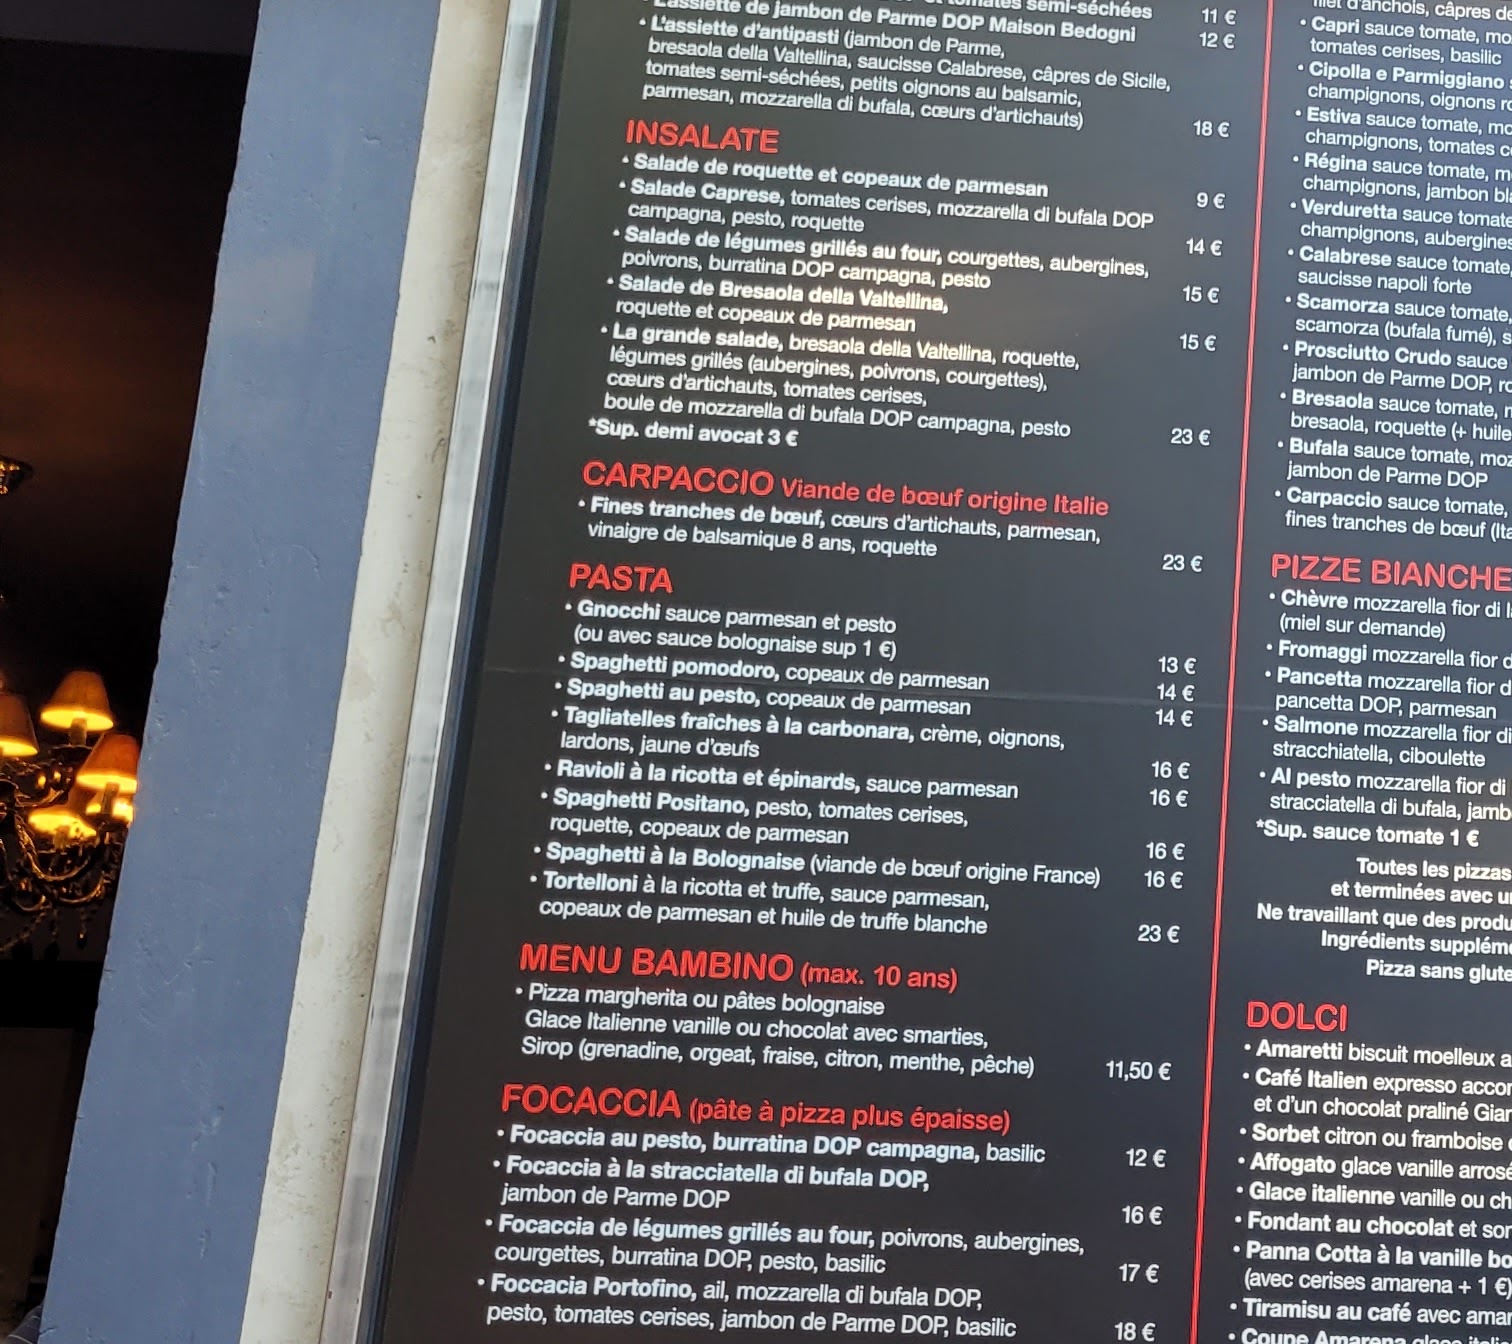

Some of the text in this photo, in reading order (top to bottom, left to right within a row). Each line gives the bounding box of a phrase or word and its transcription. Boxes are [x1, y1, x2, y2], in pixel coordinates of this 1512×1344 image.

[626, 120, 780, 153] INSALATE
[1307, 106, 1361, 124] Estiva
[1366, 114, 1416, 128] sauce
[1421, 115, 1482, 135] tomate,
[634, 153, 1225, 209] Salade de roquette et copeaux de parmesan 9 €
[1298, 270, 1372, 287] saucisse
[1377, 275, 1427, 293] napoli
[1433, 276, 1472, 294] forte
[582, 460, 1109, 516] CARPACCIO Viande de bœuf origine Italie
[569, 563, 673, 593] PASTA
[1272, 554, 1361, 583] PIZZE
[1371, 560, 1512, 591] BIANCHE
[570, 651, 1195, 701] Spaghetti pomodoro, copeaux de parmesan 14 €
[1276, 695, 1353, 711] pancetta
[1359, 695, 1402, 716] DOP,
[1409, 702, 1496, 719] parmesan
[520, 943, 957, 993] MENU BAMBINO (max. 10 ans)
[525, 1009, 988, 1049] Glace Italienne vanille ou chocolat avec smarties,
[1247, 1001, 1347, 1032] DOLCI
[501, 1084, 1010, 1136] FOCACCIA (pâte à pizza plus épaisse)
[1252, 1122, 1320, 1143] Sorbet
[1325, 1126, 1376, 1146] citron
[1382, 1132, 1406, 1147] ou
[1411, 1129, 1503, 1151] framboise
[500, 1182, 1163, 1225] jambon de Parme DOP 16 €
